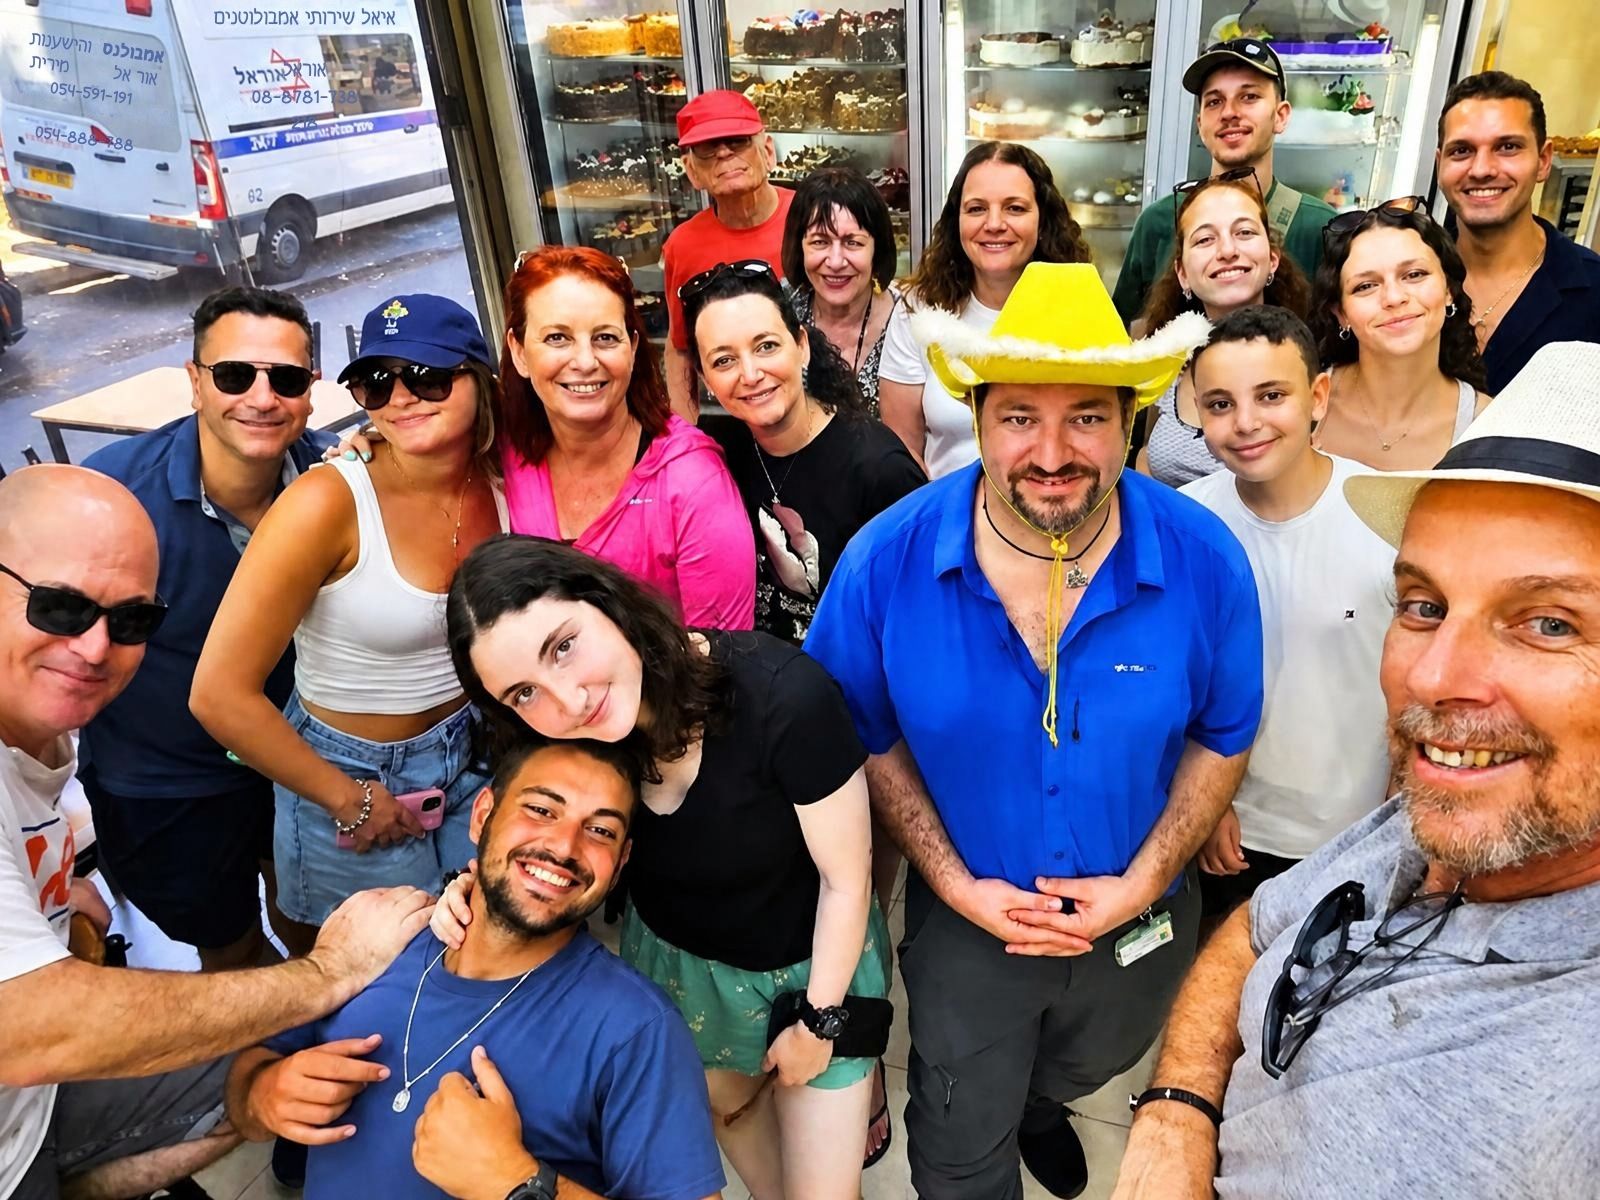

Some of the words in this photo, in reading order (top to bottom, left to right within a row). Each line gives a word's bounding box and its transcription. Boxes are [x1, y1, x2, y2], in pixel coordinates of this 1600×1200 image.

[214, 8, 299, 26] אמבולוטנים
[305, 10, 355, 26] שירותי
[361, 8, 396, 26] איאל
[102, 42, 165, 63] אמבולנס
[29, 55, 69, 73] מירית
[113, 64, 131, 82] אל
[137, 70, 158, 86] אור
[50, 81, 133, 105] 054-591-191
